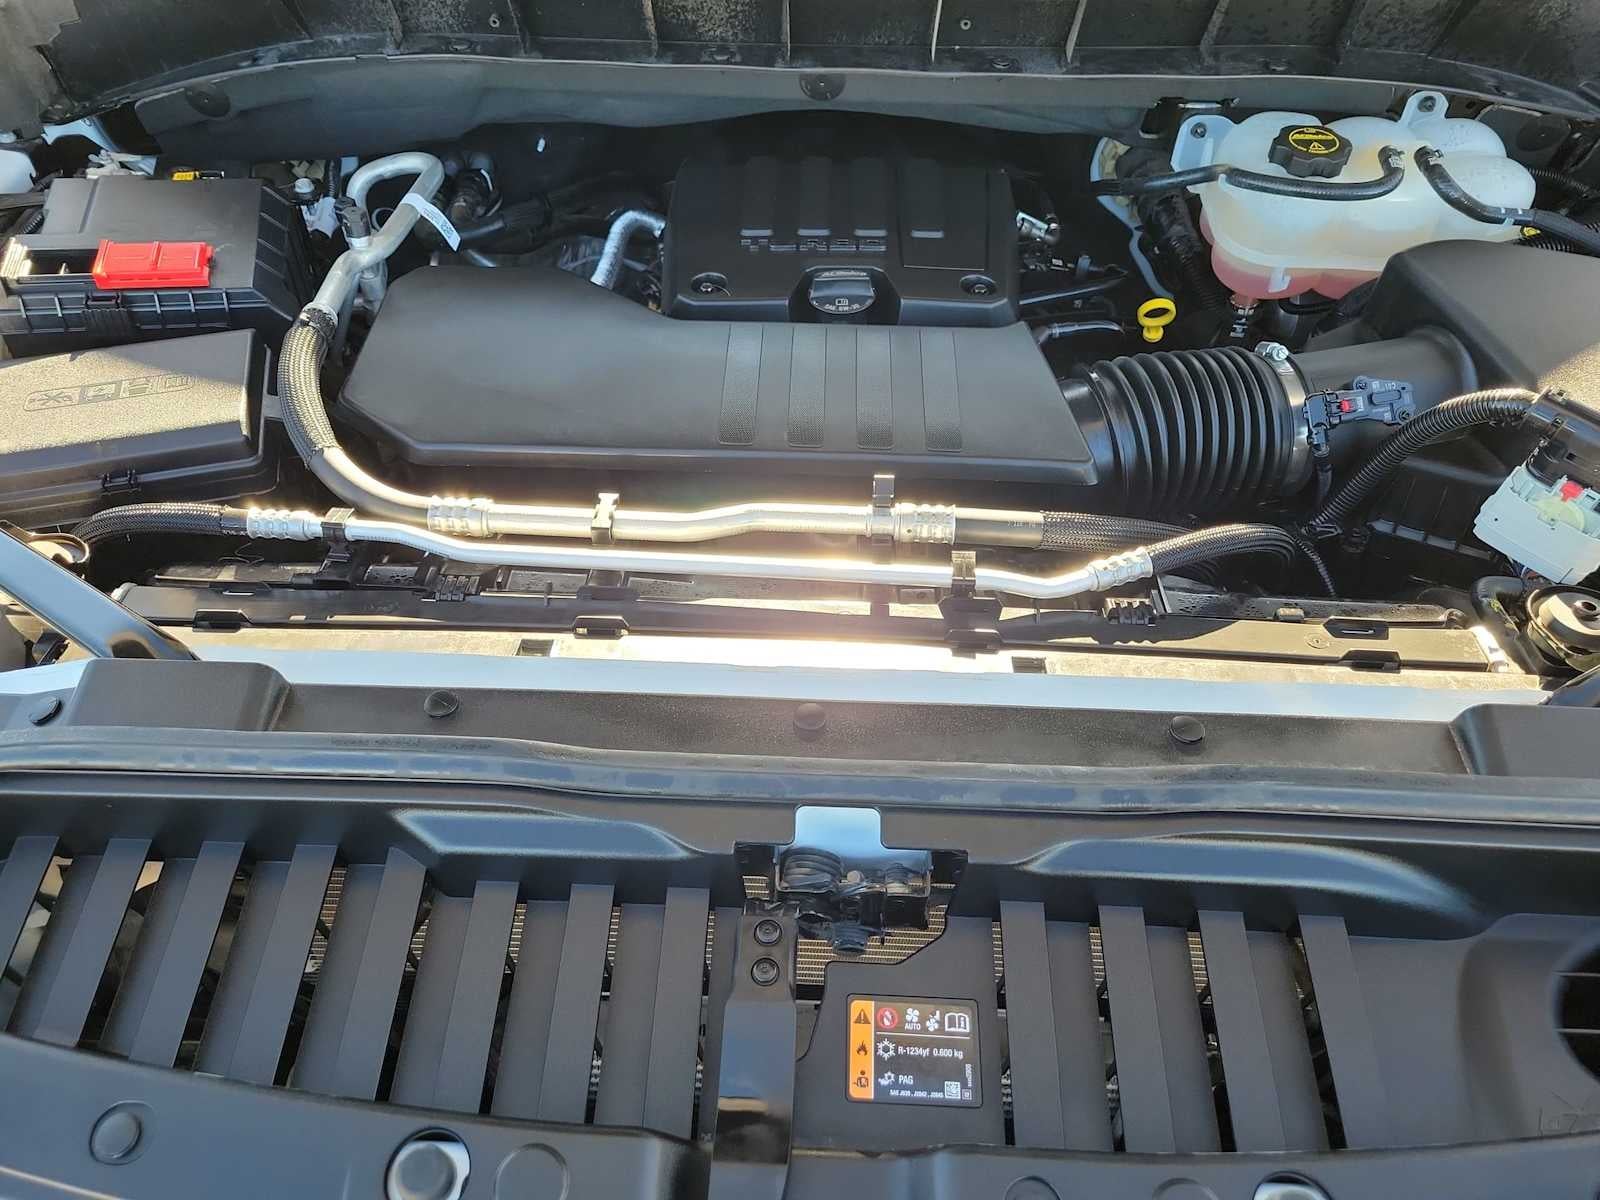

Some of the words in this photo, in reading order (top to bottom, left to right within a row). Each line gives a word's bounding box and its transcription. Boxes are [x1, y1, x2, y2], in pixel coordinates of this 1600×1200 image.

[905, 1023, 921, 1031] AUTO
[898, 1046, 930, 1057] R-1234yf
[954, 1050, 963, 1060] kg
[898, 1075, 914, 1085] PAG
